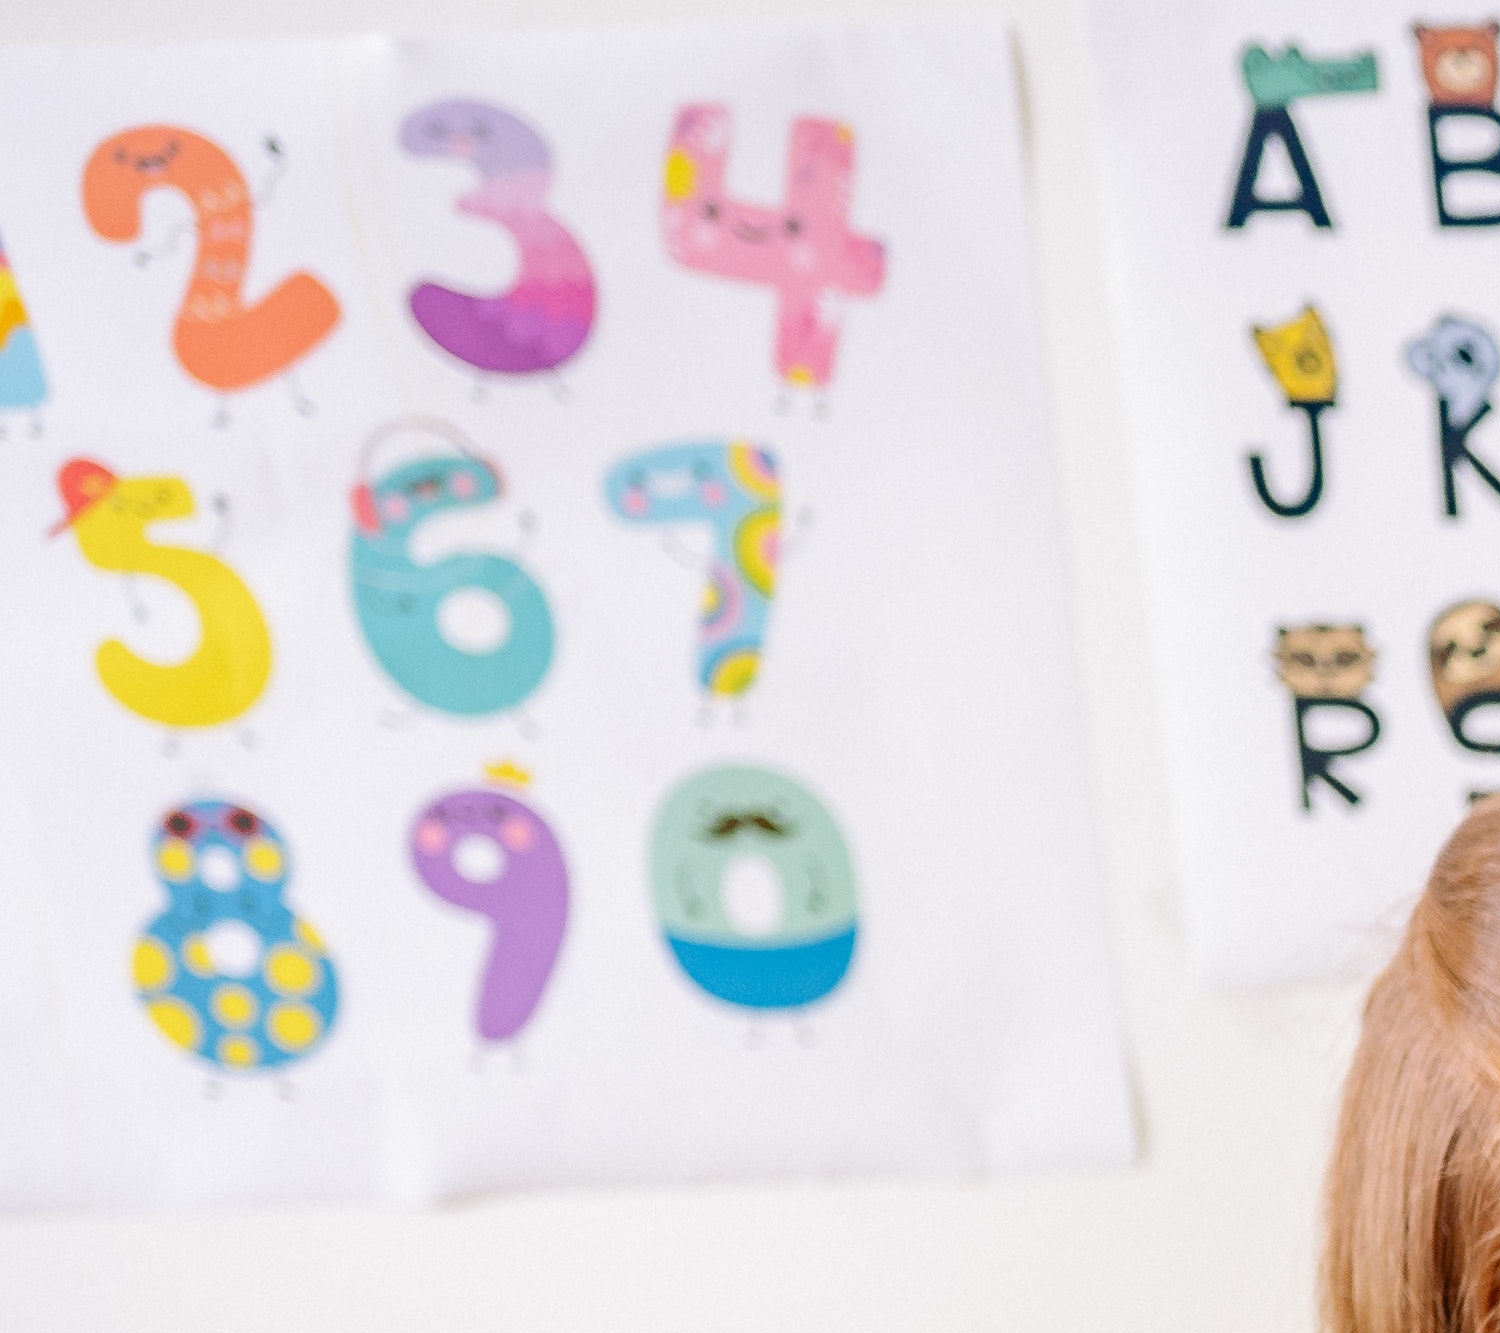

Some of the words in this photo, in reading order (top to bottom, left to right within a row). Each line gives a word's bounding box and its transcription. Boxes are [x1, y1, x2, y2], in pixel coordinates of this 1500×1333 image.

[78, 121, 345, 394] 2
[397, 97, 603, 379] 3
[659, 102, 889, 389] 4
[1225, 101, 1334, 231] A
[1245, 395, 1340, 519] J
[70, 473, 277, 732] 5
[347, 454, 559, 722] 6
[601, 439, 786, 700] 7
[1292, 692, 1382, 810] R
[130, 799, 345, 1077] 8
[406, 786, 574, 1046] 9
[646, 760, 864, 1016] 0
